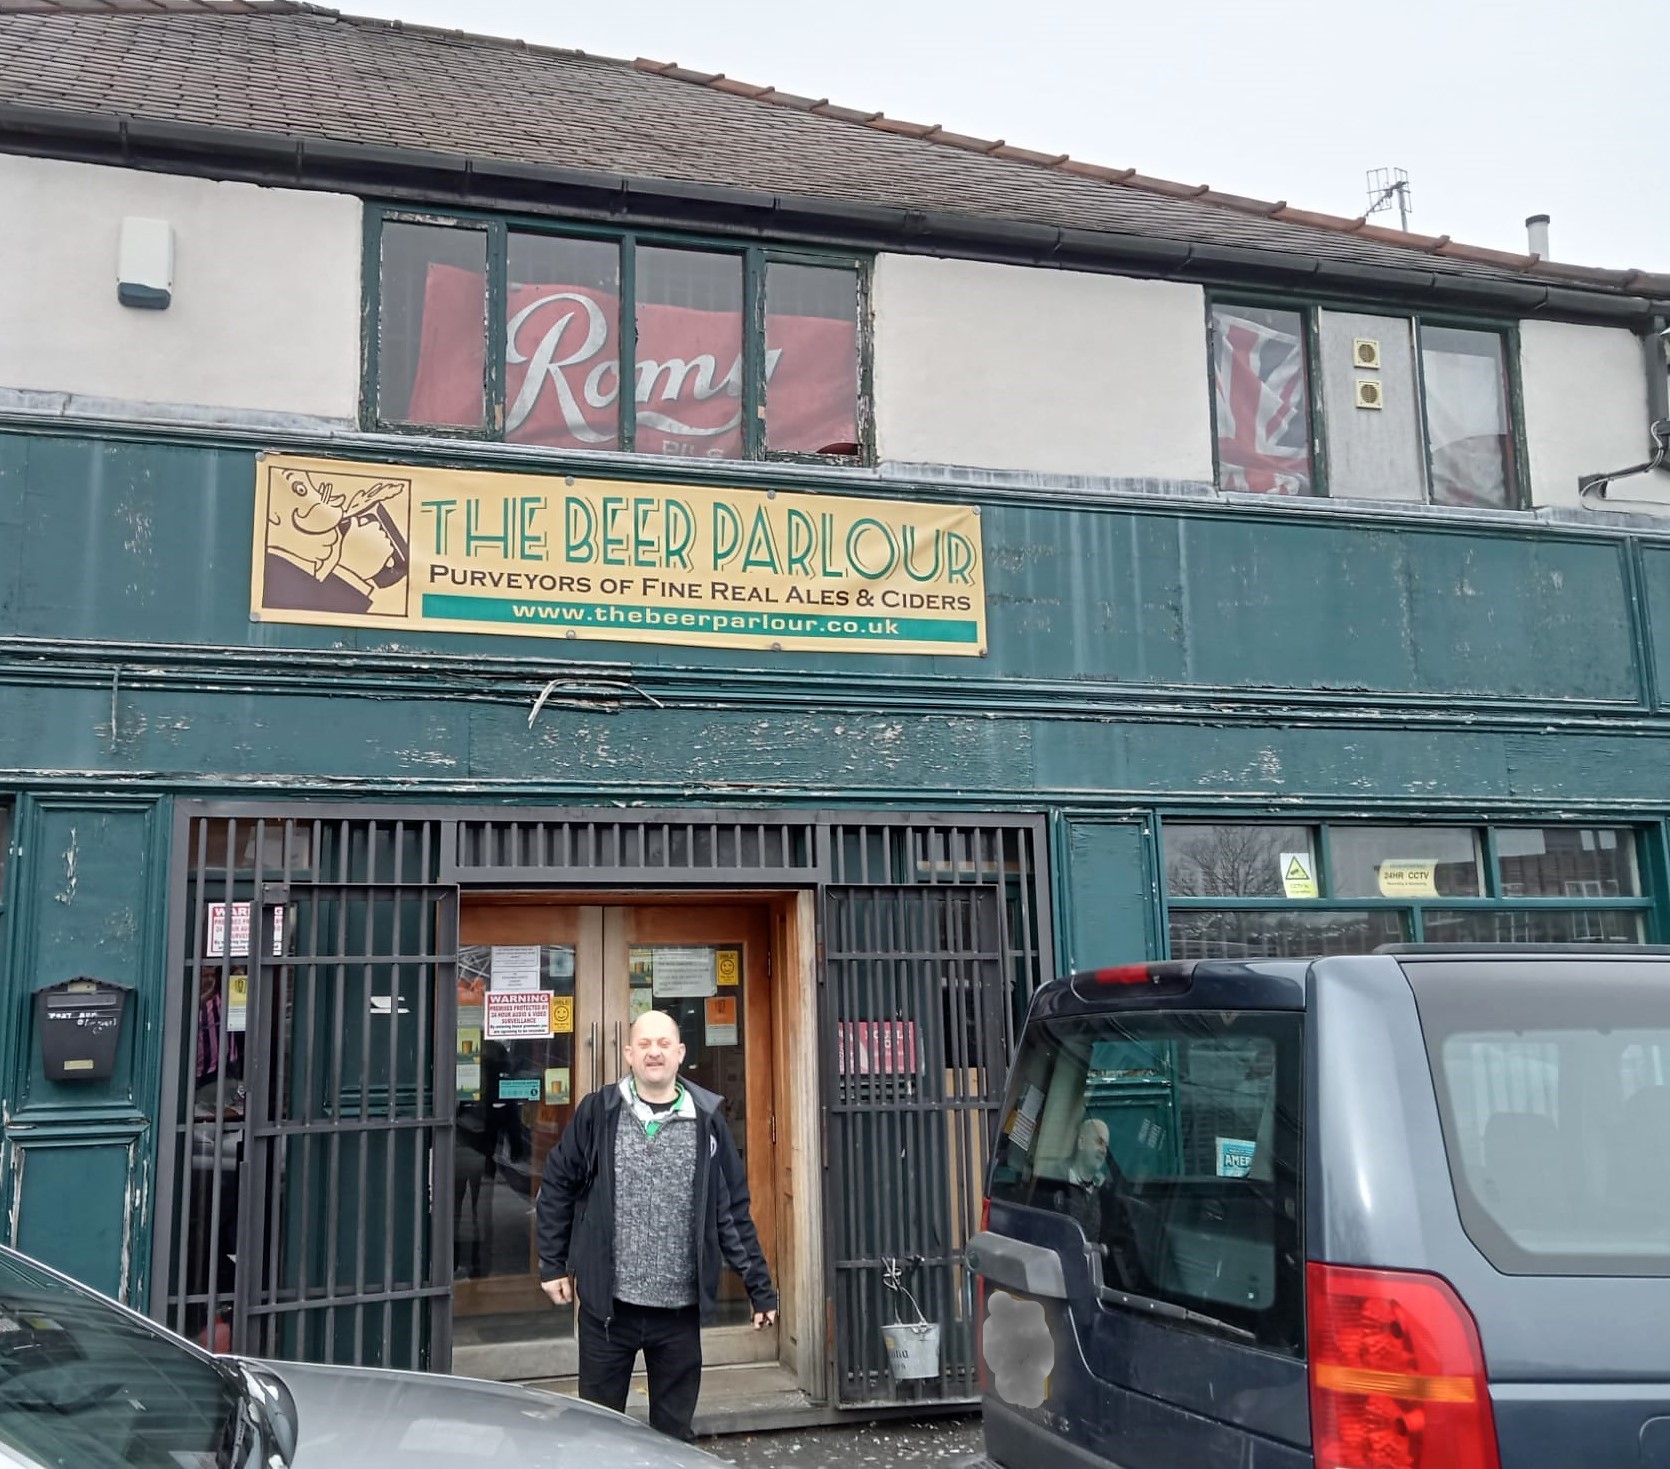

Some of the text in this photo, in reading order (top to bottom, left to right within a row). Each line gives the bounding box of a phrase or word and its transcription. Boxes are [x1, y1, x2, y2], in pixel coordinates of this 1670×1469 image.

[421, 496, 977, 587] THE BEER PARLOUR
[429, 564, 971, 611] PURVEYORS OF FINE REAL ALES & CIDERS
[512, 604, 899, 635] www.thebeerparlour.co.uk
[1408, 871, 1429, 880] CCTV
[490, 994, 549, 1003] WARNING
